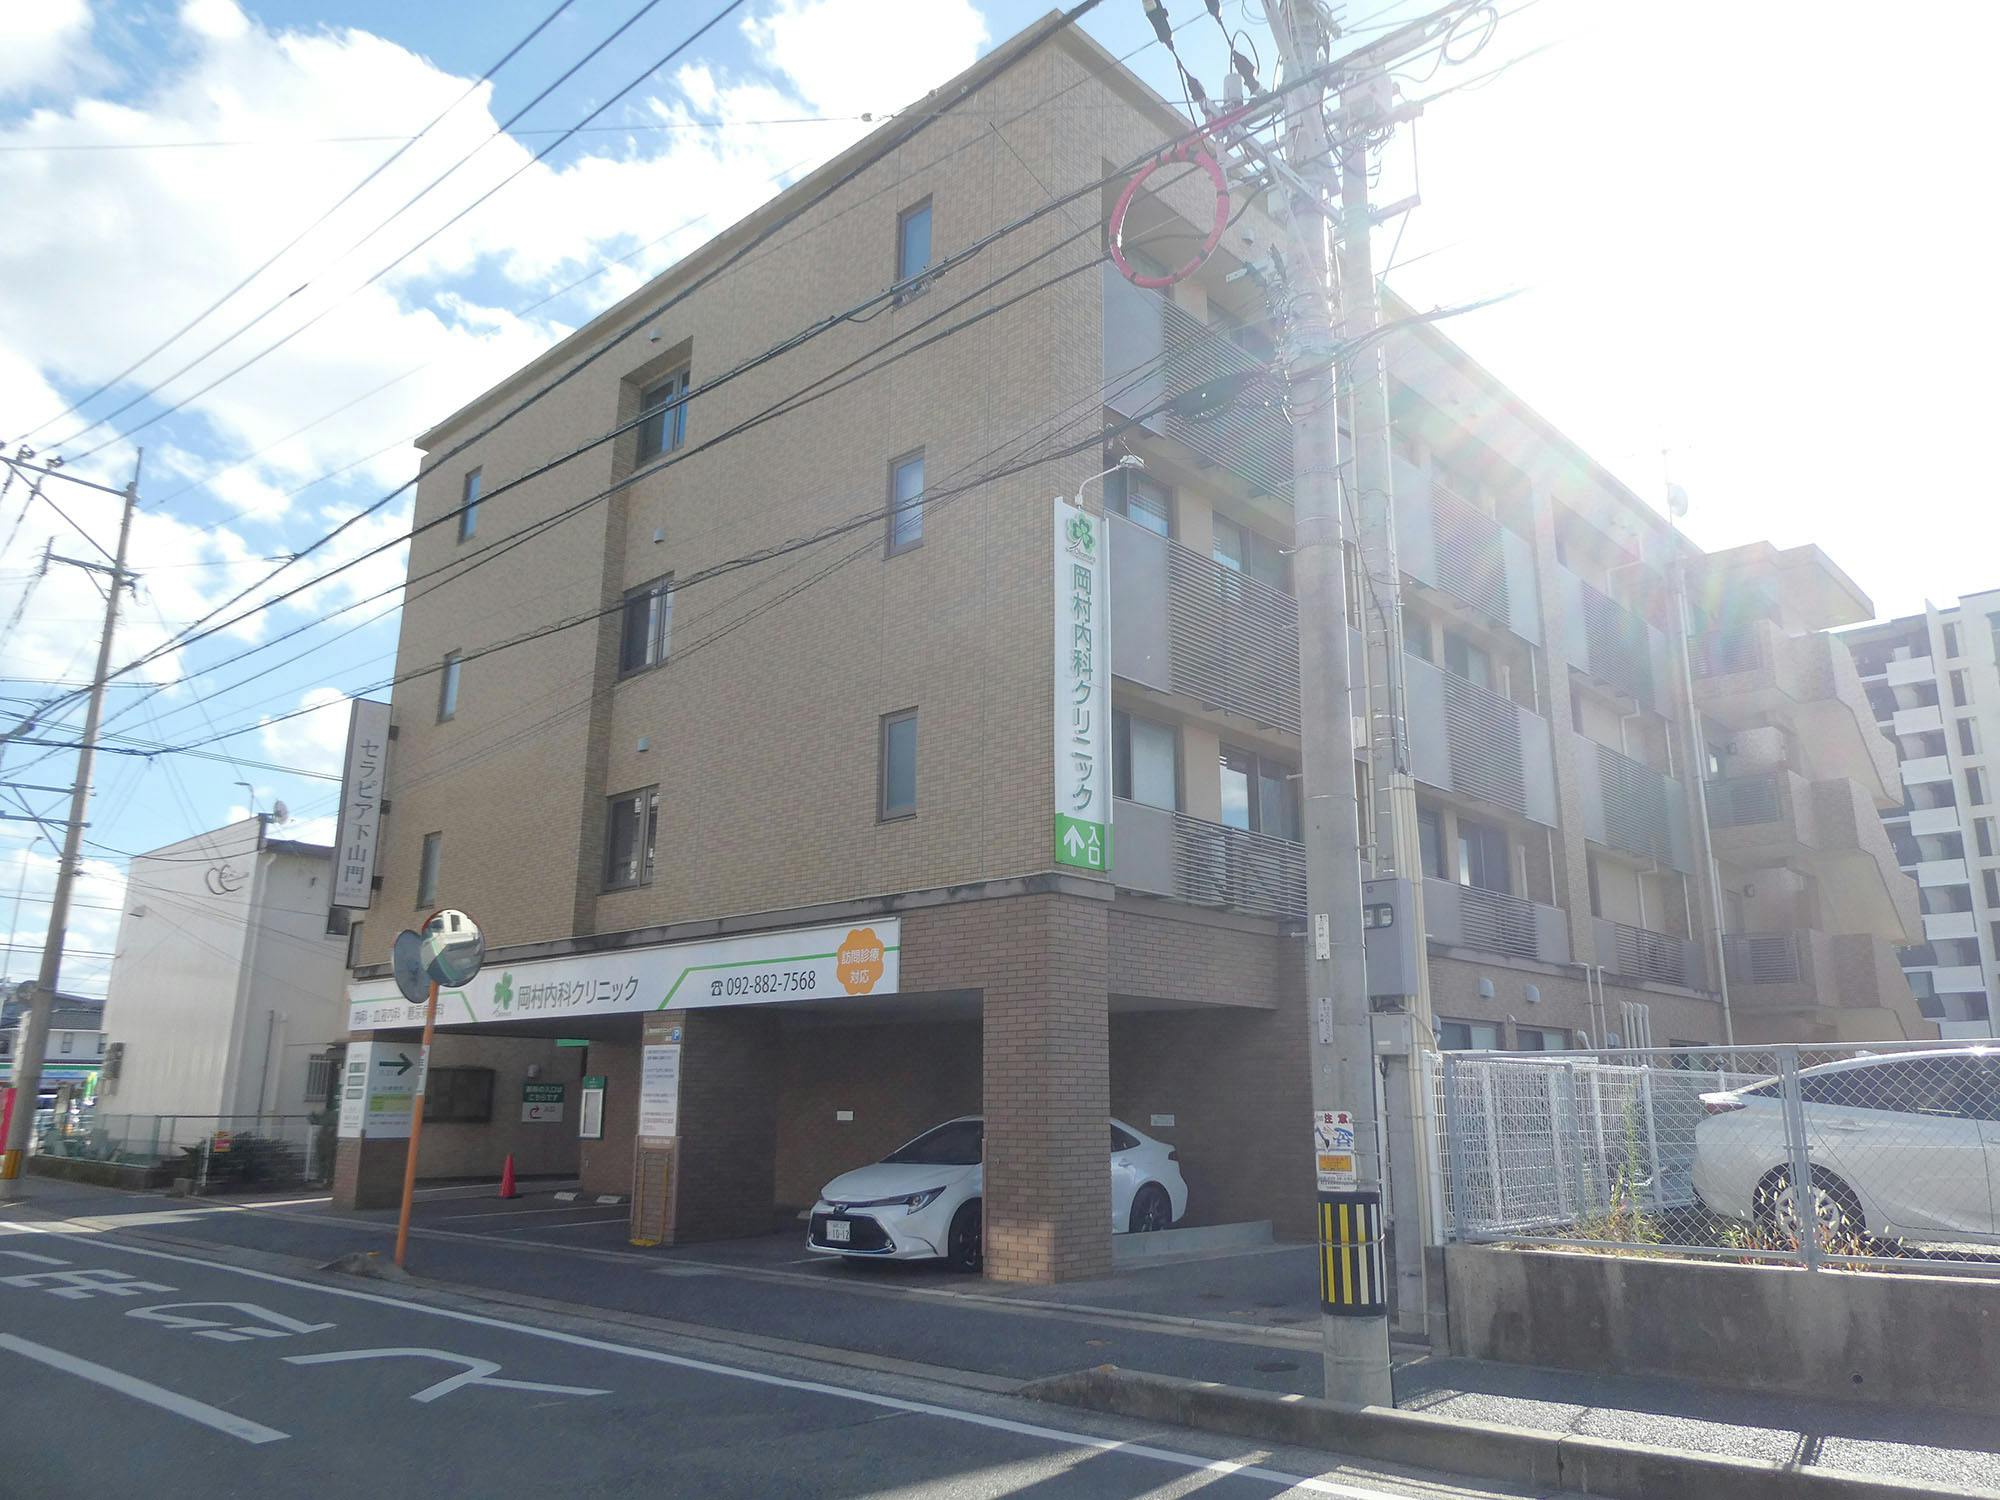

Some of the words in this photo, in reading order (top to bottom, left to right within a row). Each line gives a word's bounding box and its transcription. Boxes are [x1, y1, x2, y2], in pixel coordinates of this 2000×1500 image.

[1071, 562, 1094, 812] 岡村内科クリニック
[344, 738, 379, 885] セラピア下山門
[1087, 825, 1101, 865] 入口
[841, 947, 880, 965] 訪問診療
[726, 970, 816, 996] 092-882-7568
[849, 969, 870, 985] 対応
[517, 975, 639, 1010] 岡村内科クリニック
[1324, 1112, 1348, 1125] 注意
